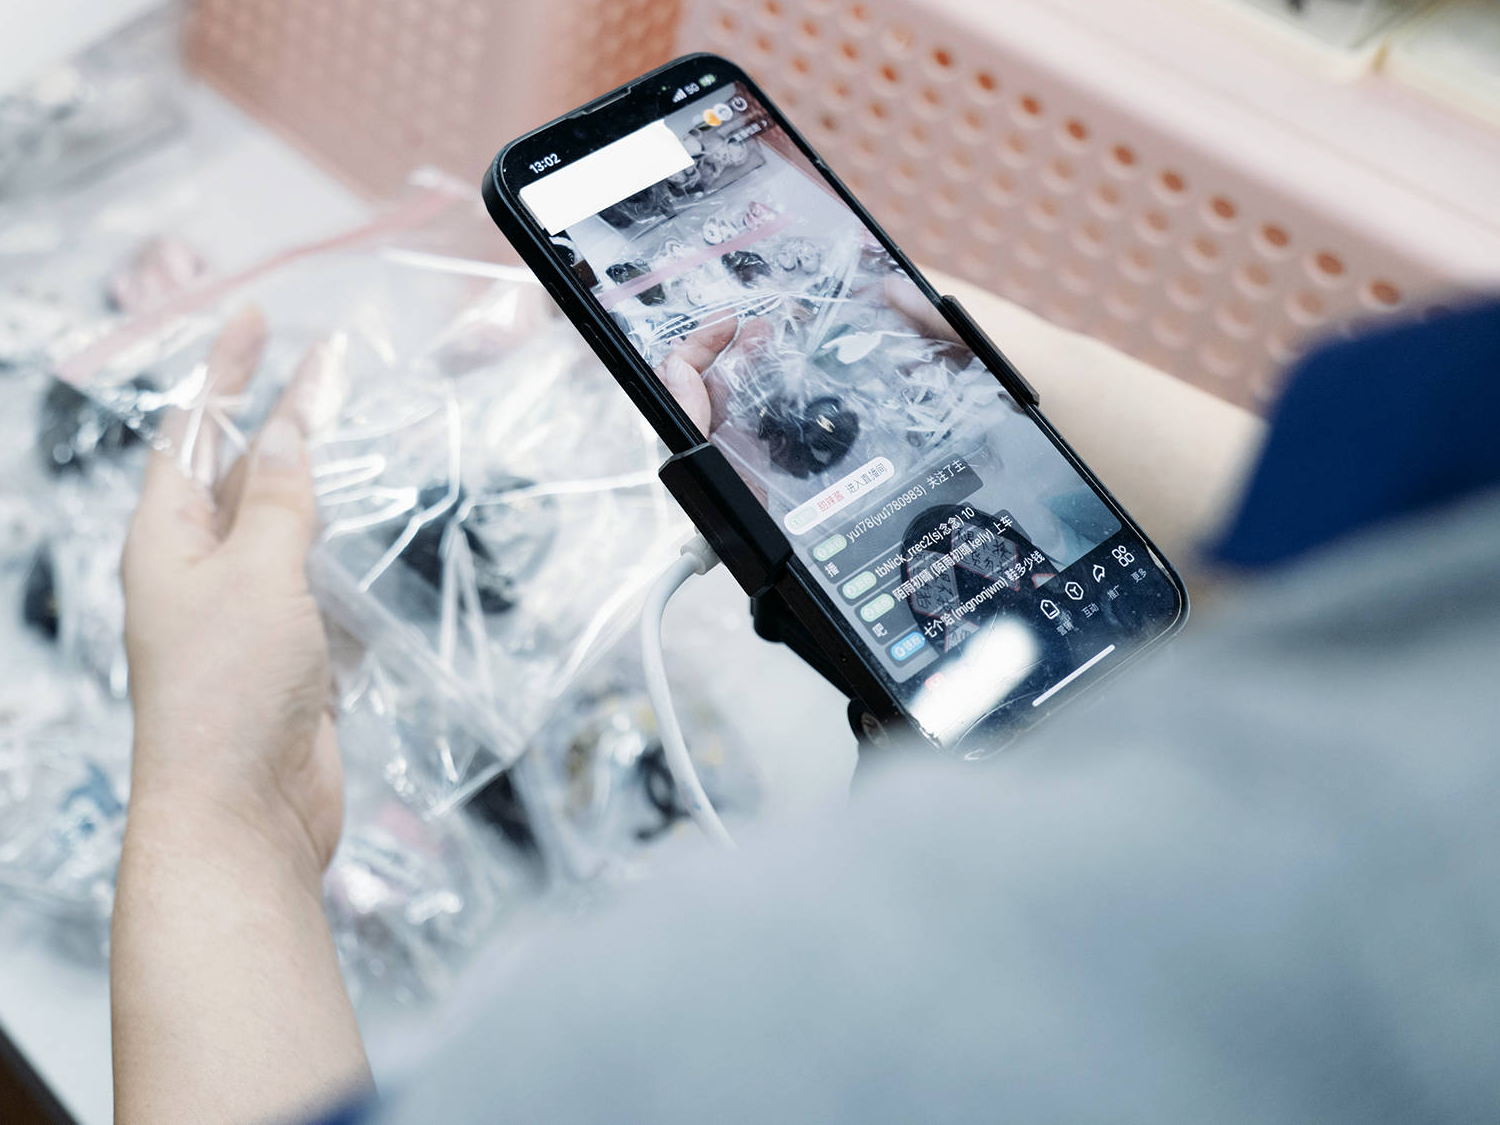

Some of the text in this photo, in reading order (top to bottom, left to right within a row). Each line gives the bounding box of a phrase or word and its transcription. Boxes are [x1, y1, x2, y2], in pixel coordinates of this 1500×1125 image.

[528, 153, 562, 175] 13:02
[845, 462, 887, 494] 进入直播间
[846, 483, 926, 542] yu178(yu1780983)
[927, 459, 965, 489] 关注了主
[961, 506, 975, 520] 10
[993, 515, 1013, 534] 上车
[1007, 550, 1045, 582] 鞋多少钱
[1082, 602, 1099, 617] 互动
[872, 622, 888, 638] 吧
